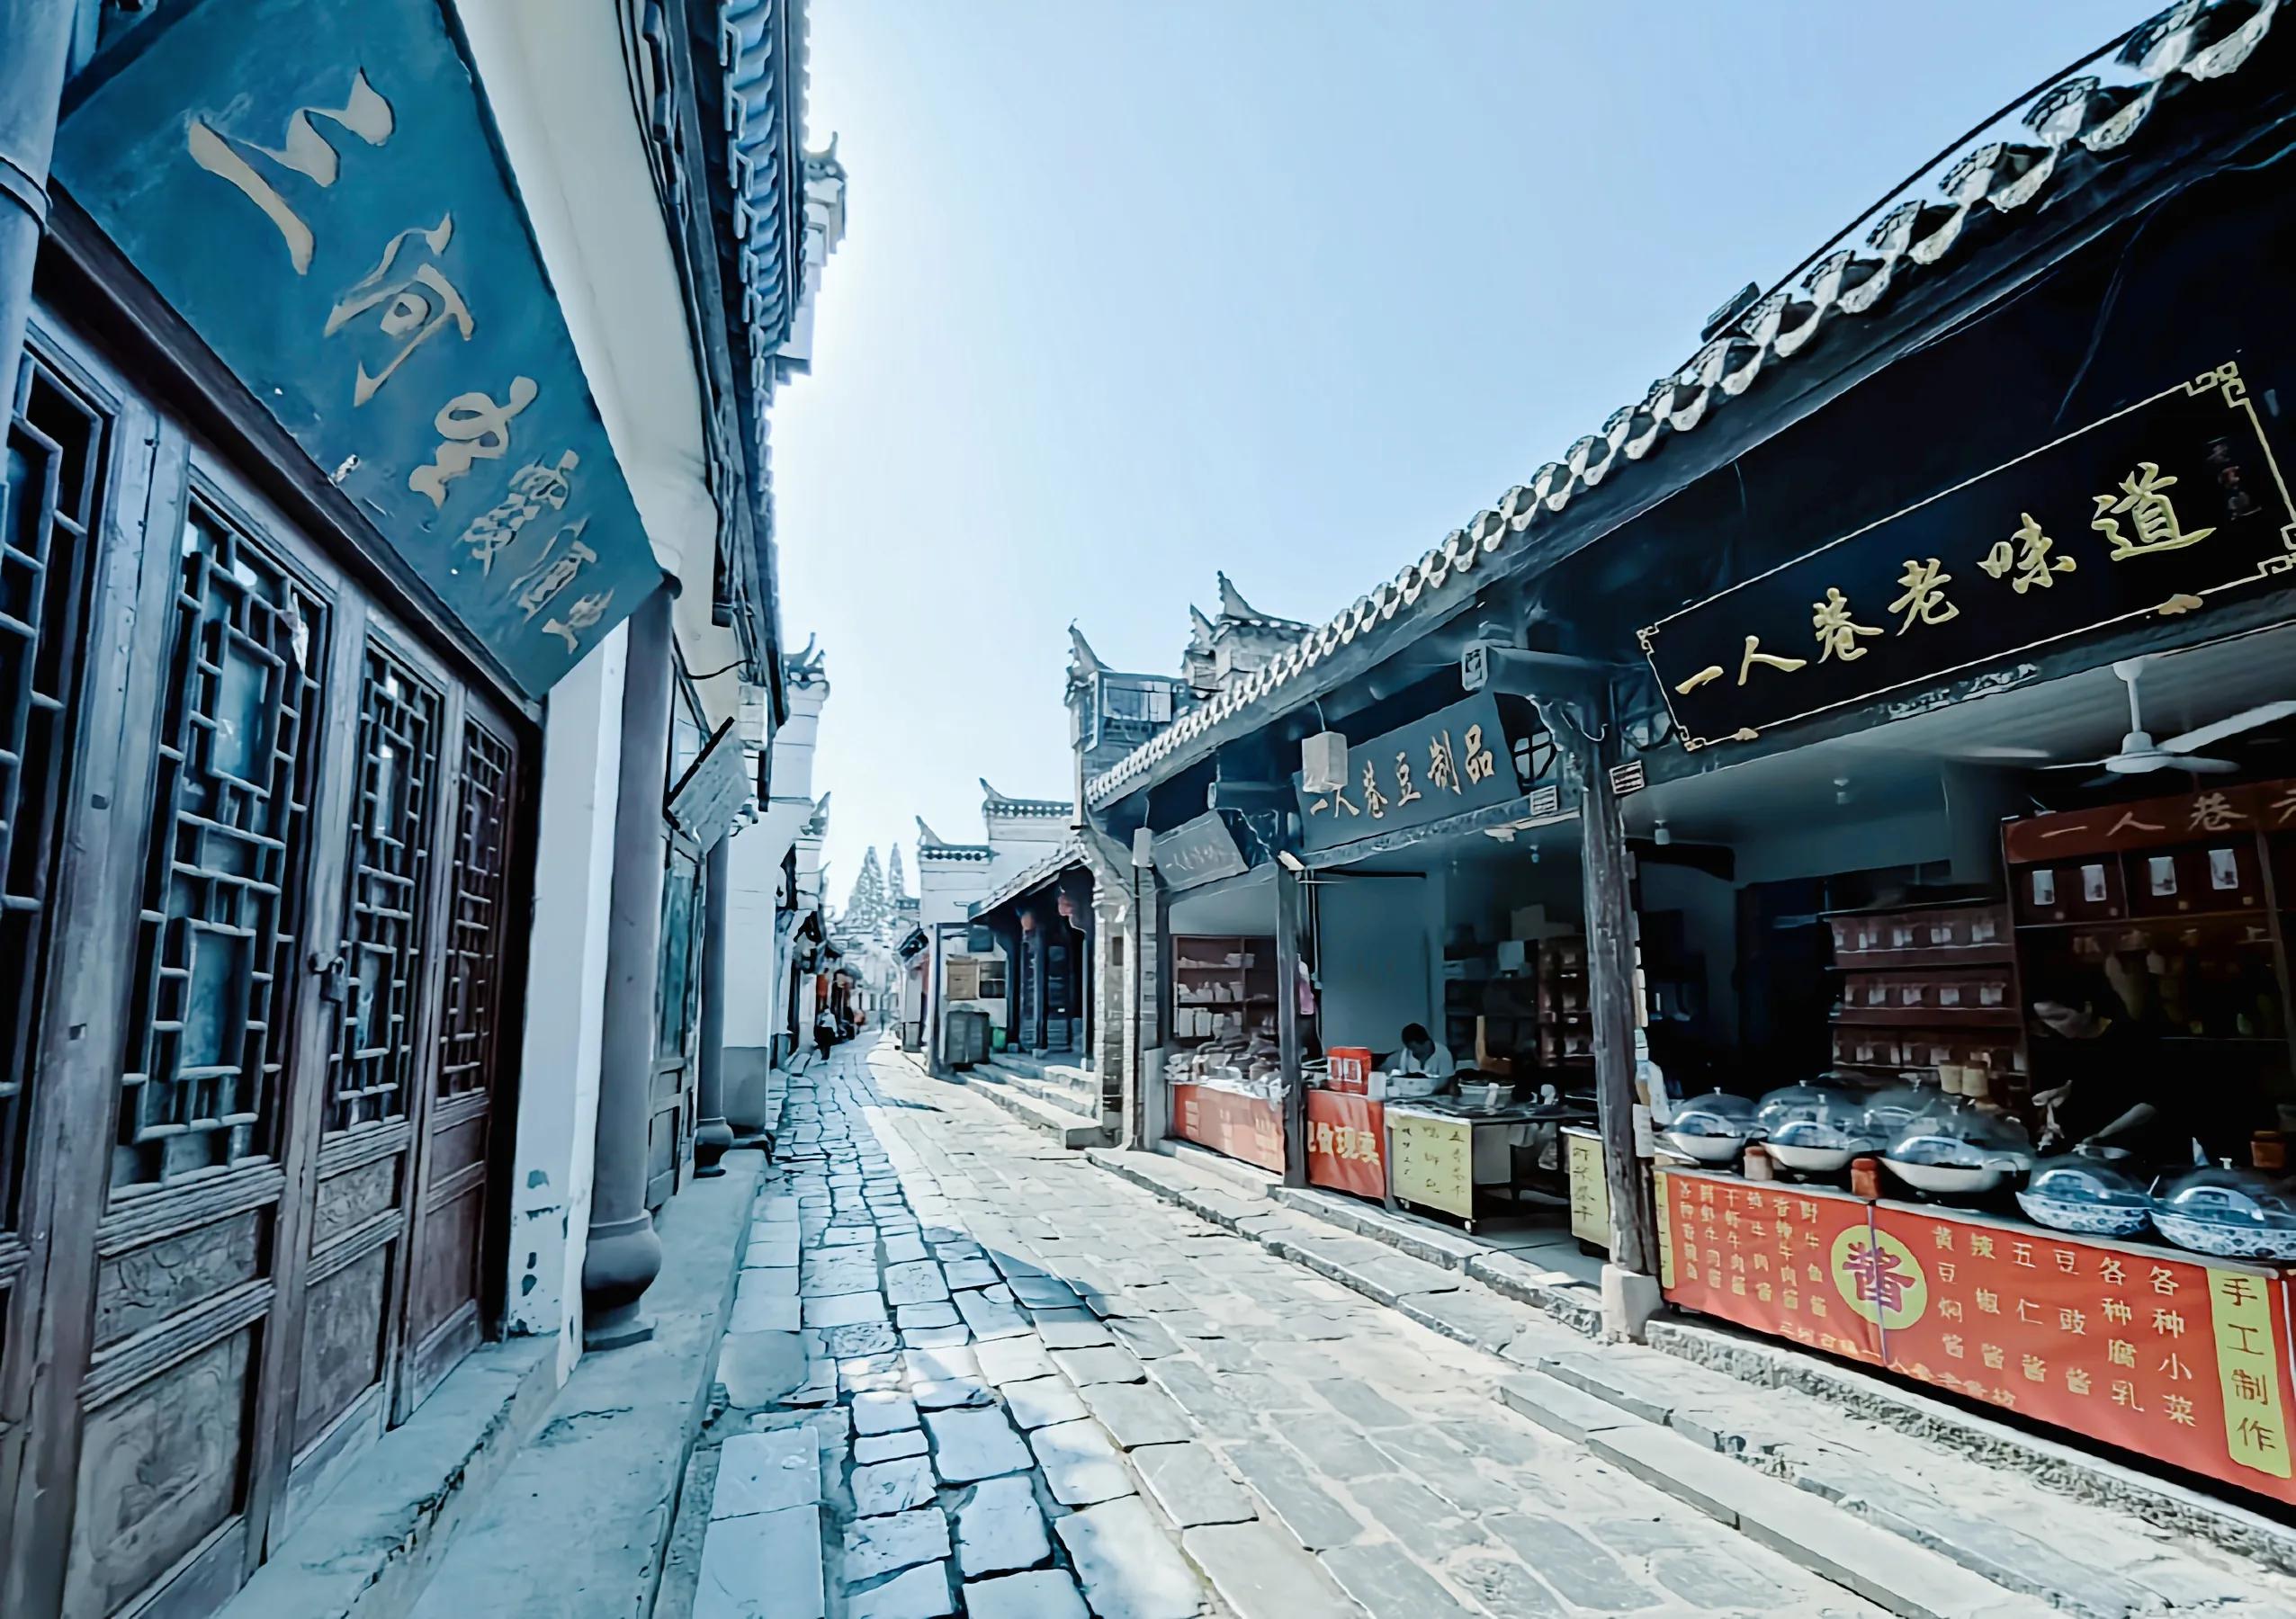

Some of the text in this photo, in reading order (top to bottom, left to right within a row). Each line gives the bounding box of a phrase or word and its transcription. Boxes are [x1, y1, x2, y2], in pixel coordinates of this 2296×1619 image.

[1675, 462, 2217, 694] 一人巷老味道
[1310, 724, 1494, 818] 一人巷豆制品
[1843, 1241, 1916, 1313] 酱
[2013, 1241, 2047, 1382] 五仁酱
[2052, 1248, 2092, 1396] 豆豉酱
[2099, 1257, 2145, 1413] 各种腐乳
[2149, 1266, 2197, 1427] 各种小菜
[2220, 1277, 2276, 1452] 手工制作
